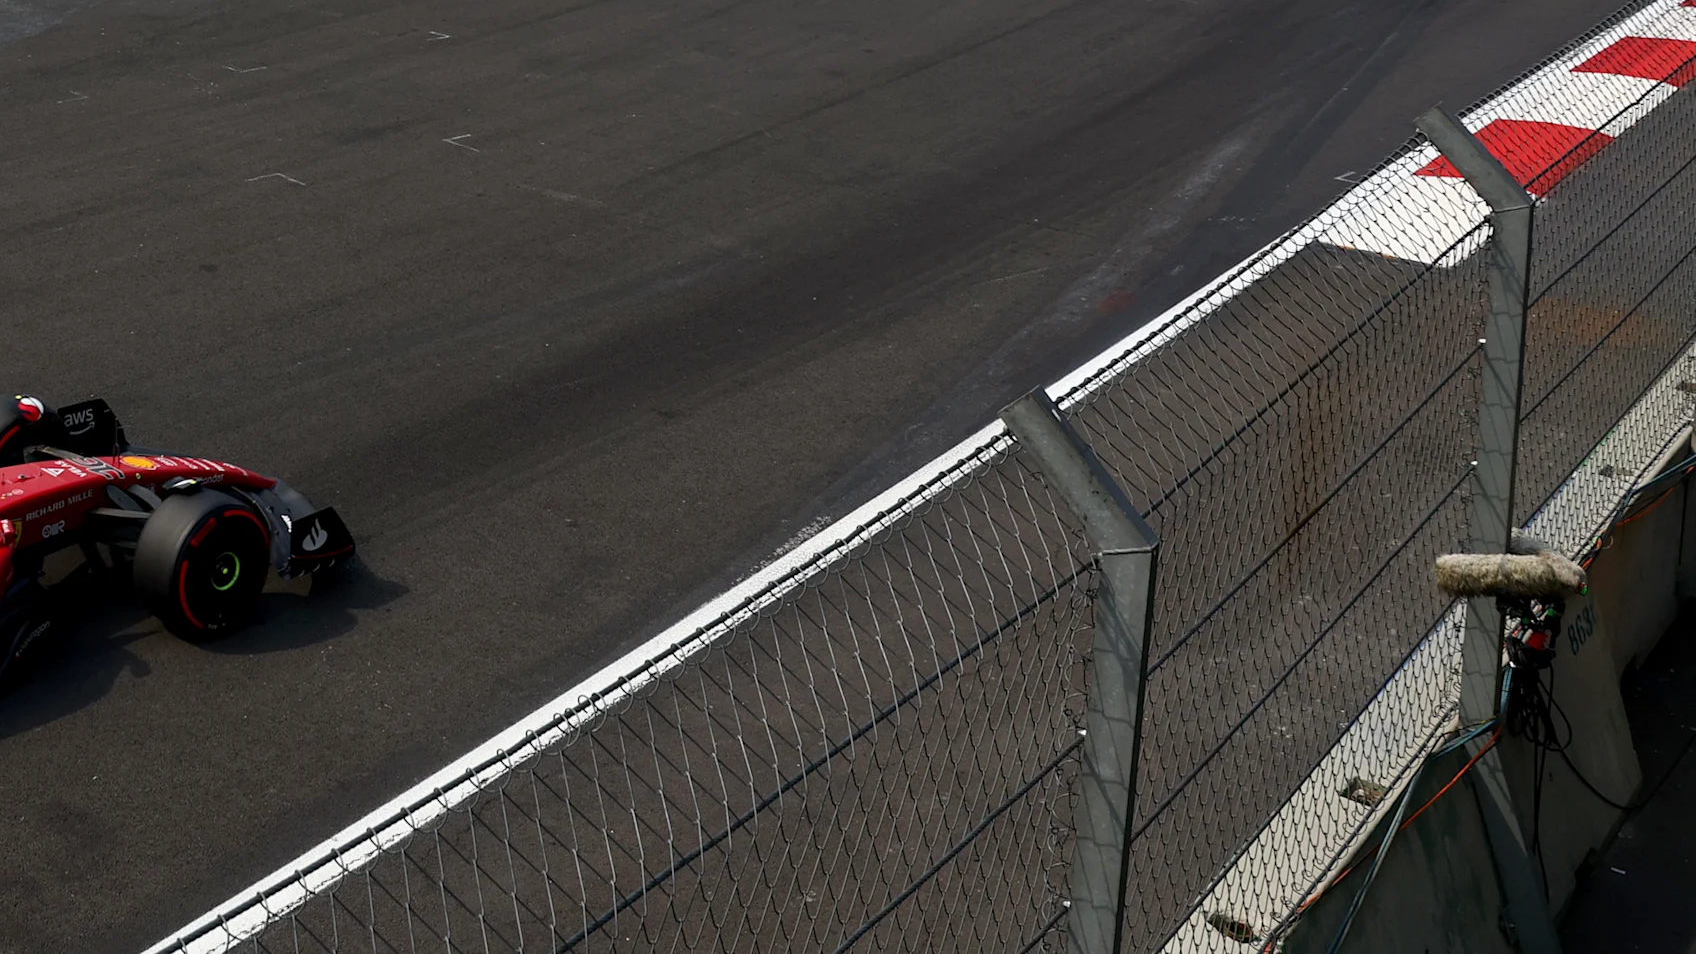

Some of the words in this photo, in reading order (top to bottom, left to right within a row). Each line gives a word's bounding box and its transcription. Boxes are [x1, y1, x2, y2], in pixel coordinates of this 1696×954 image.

[63, 408, 94, 428] aws
[25, 498, 66, 522] RICHARD
[67, 487, 94, 507] MILLE
